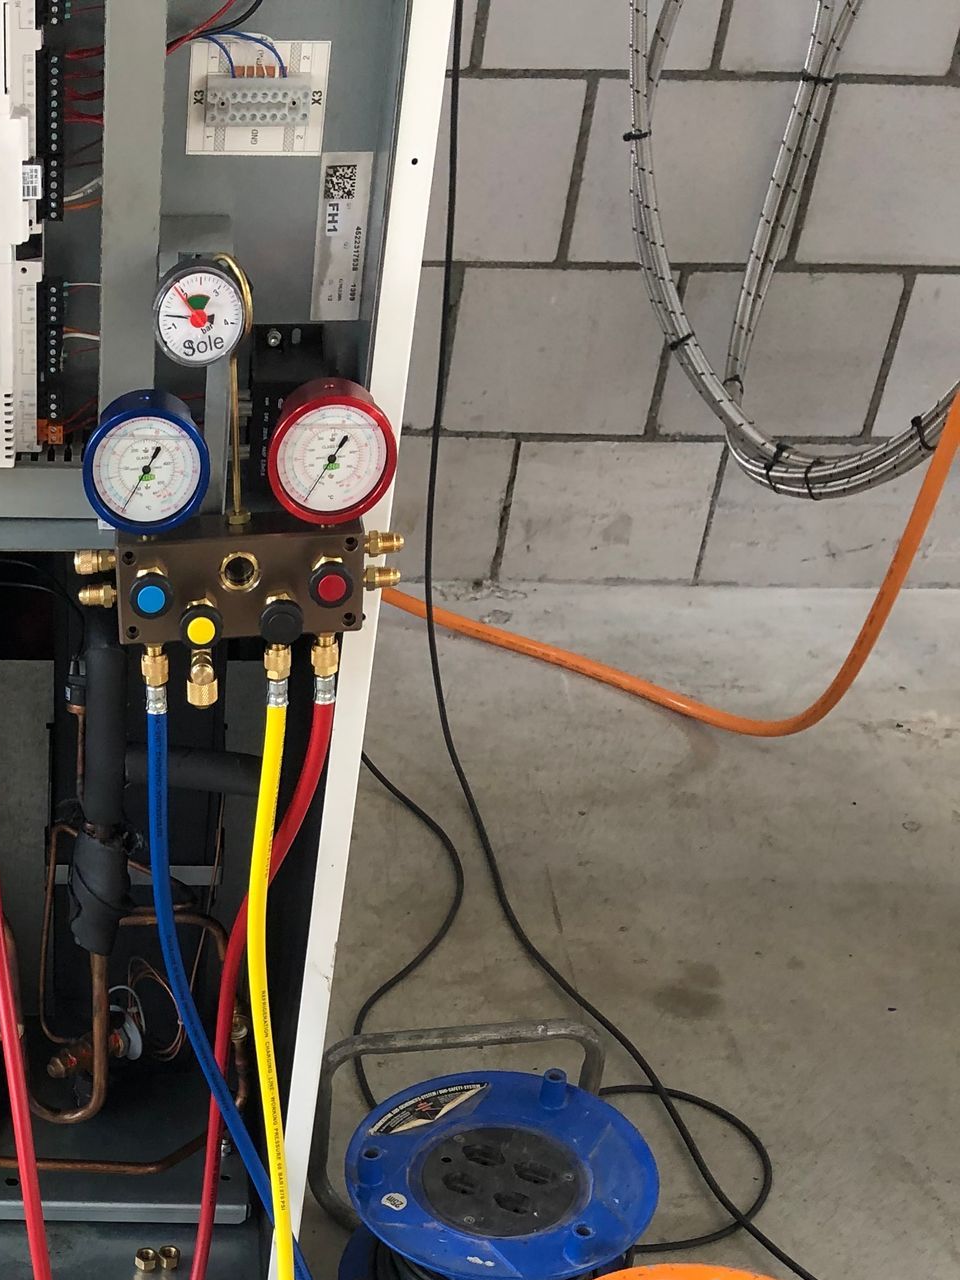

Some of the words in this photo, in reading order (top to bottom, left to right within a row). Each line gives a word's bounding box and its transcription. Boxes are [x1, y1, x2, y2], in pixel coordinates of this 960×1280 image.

[193, 90, 205, 105] X3
[311, 90, 323, 106] X3
[250, 129, 259, 145] GND
[327, 202, 340, 233] FH1
[212, 289, 220, 297] 3
[171, 322, 177, 330] 1
[200, 324, 213, 335] bar
[183, 335, 224, 357] Sole
[270, 1096, 278, 1126] WORKING
